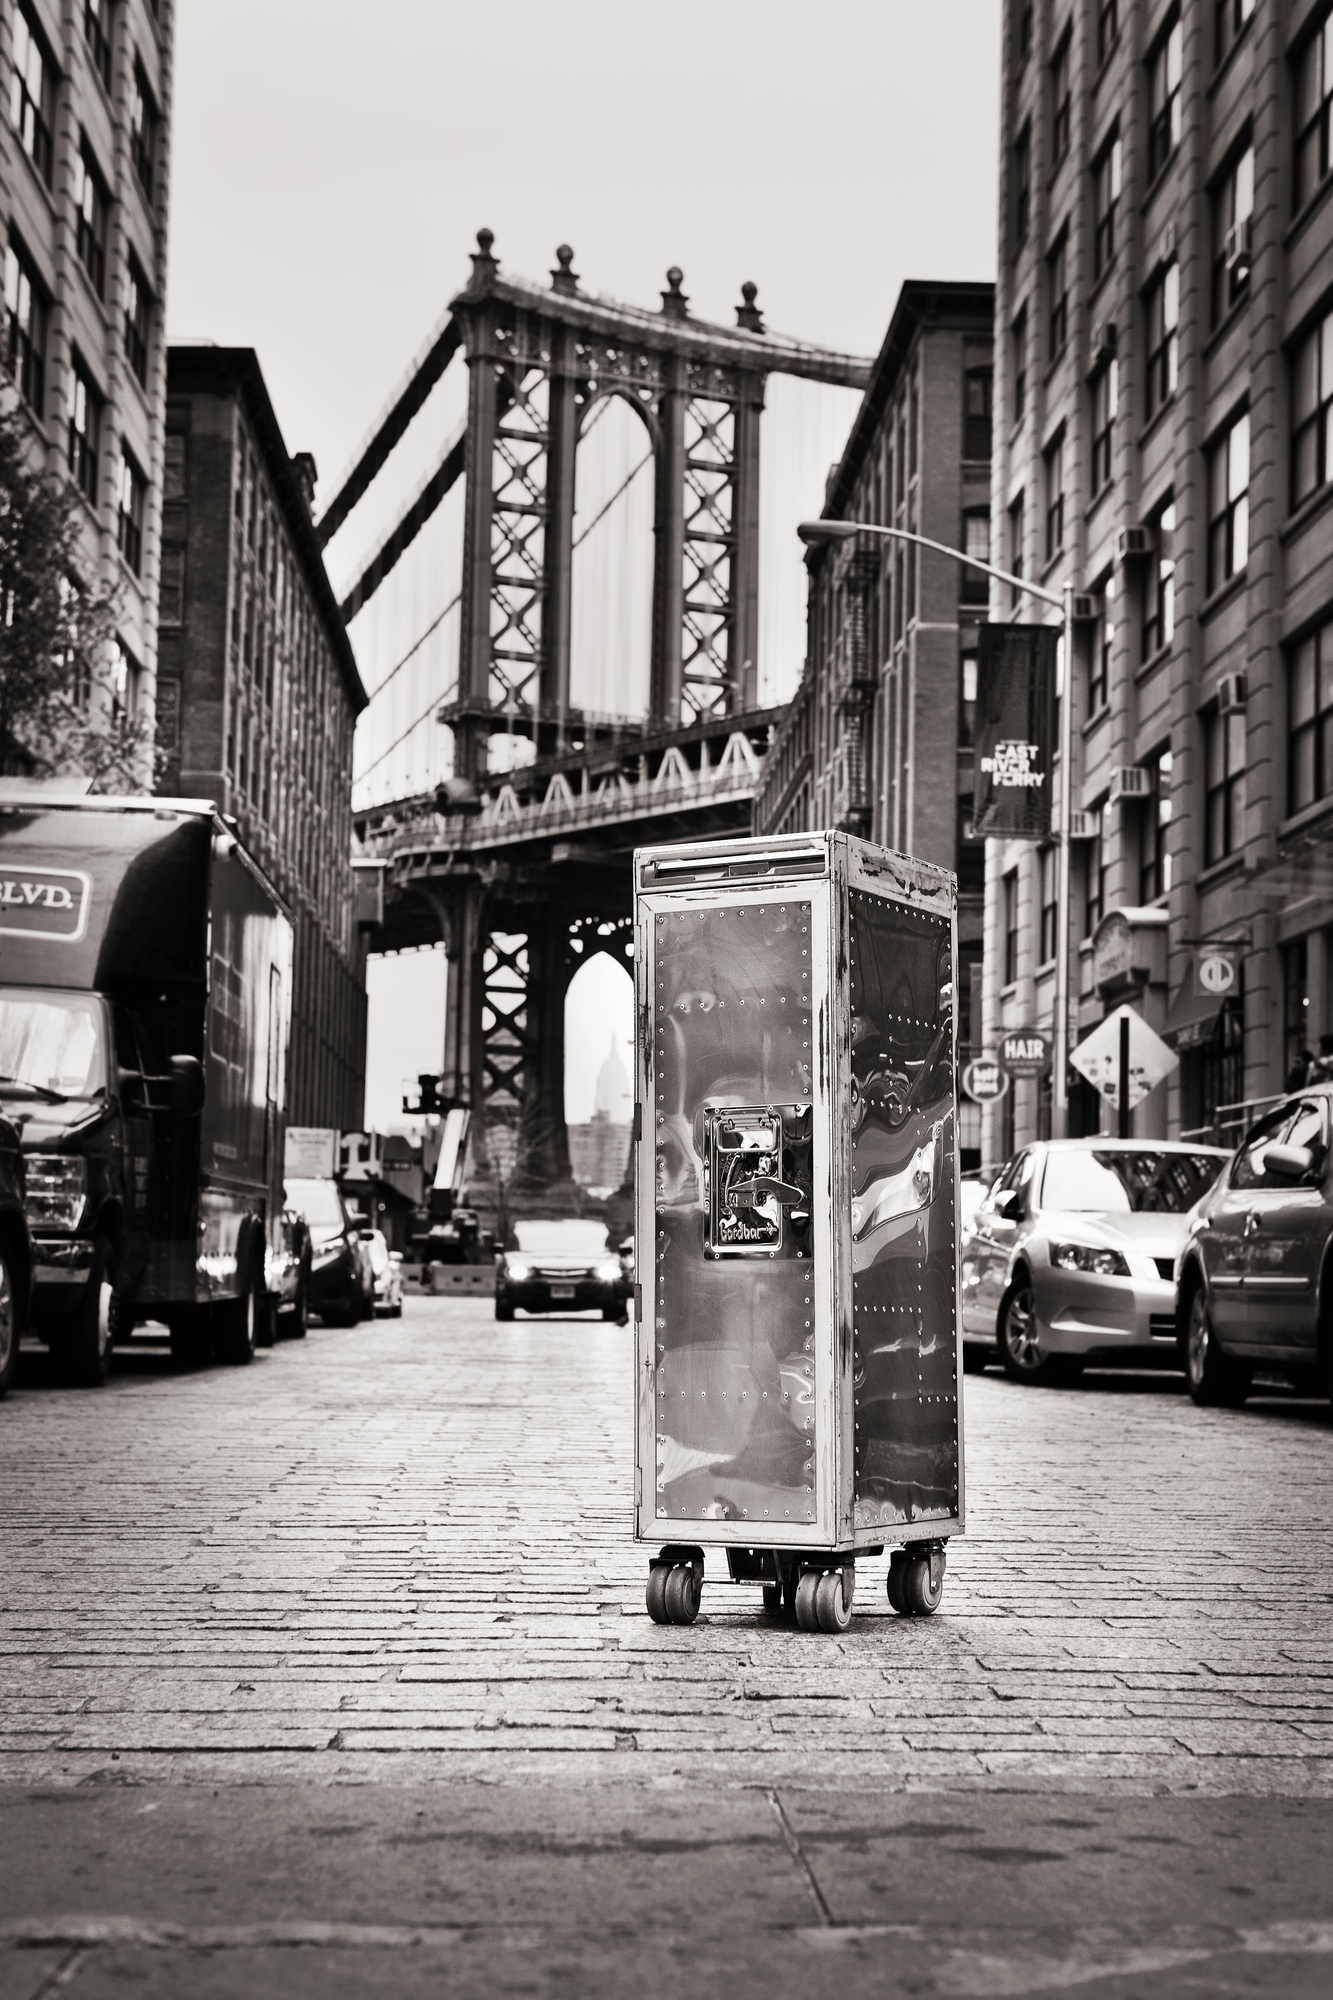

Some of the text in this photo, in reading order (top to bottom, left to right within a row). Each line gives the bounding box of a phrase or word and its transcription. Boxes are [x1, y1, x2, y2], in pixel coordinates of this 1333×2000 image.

[995, 744, 1039, 760] EAST
[981, 758, 1030, 773] RIVER
[993, 772, 1045, 787] FERRY
[0, 880, 74, 909] LVD.
[1004, 1039, 1045, 1060] HAIR
